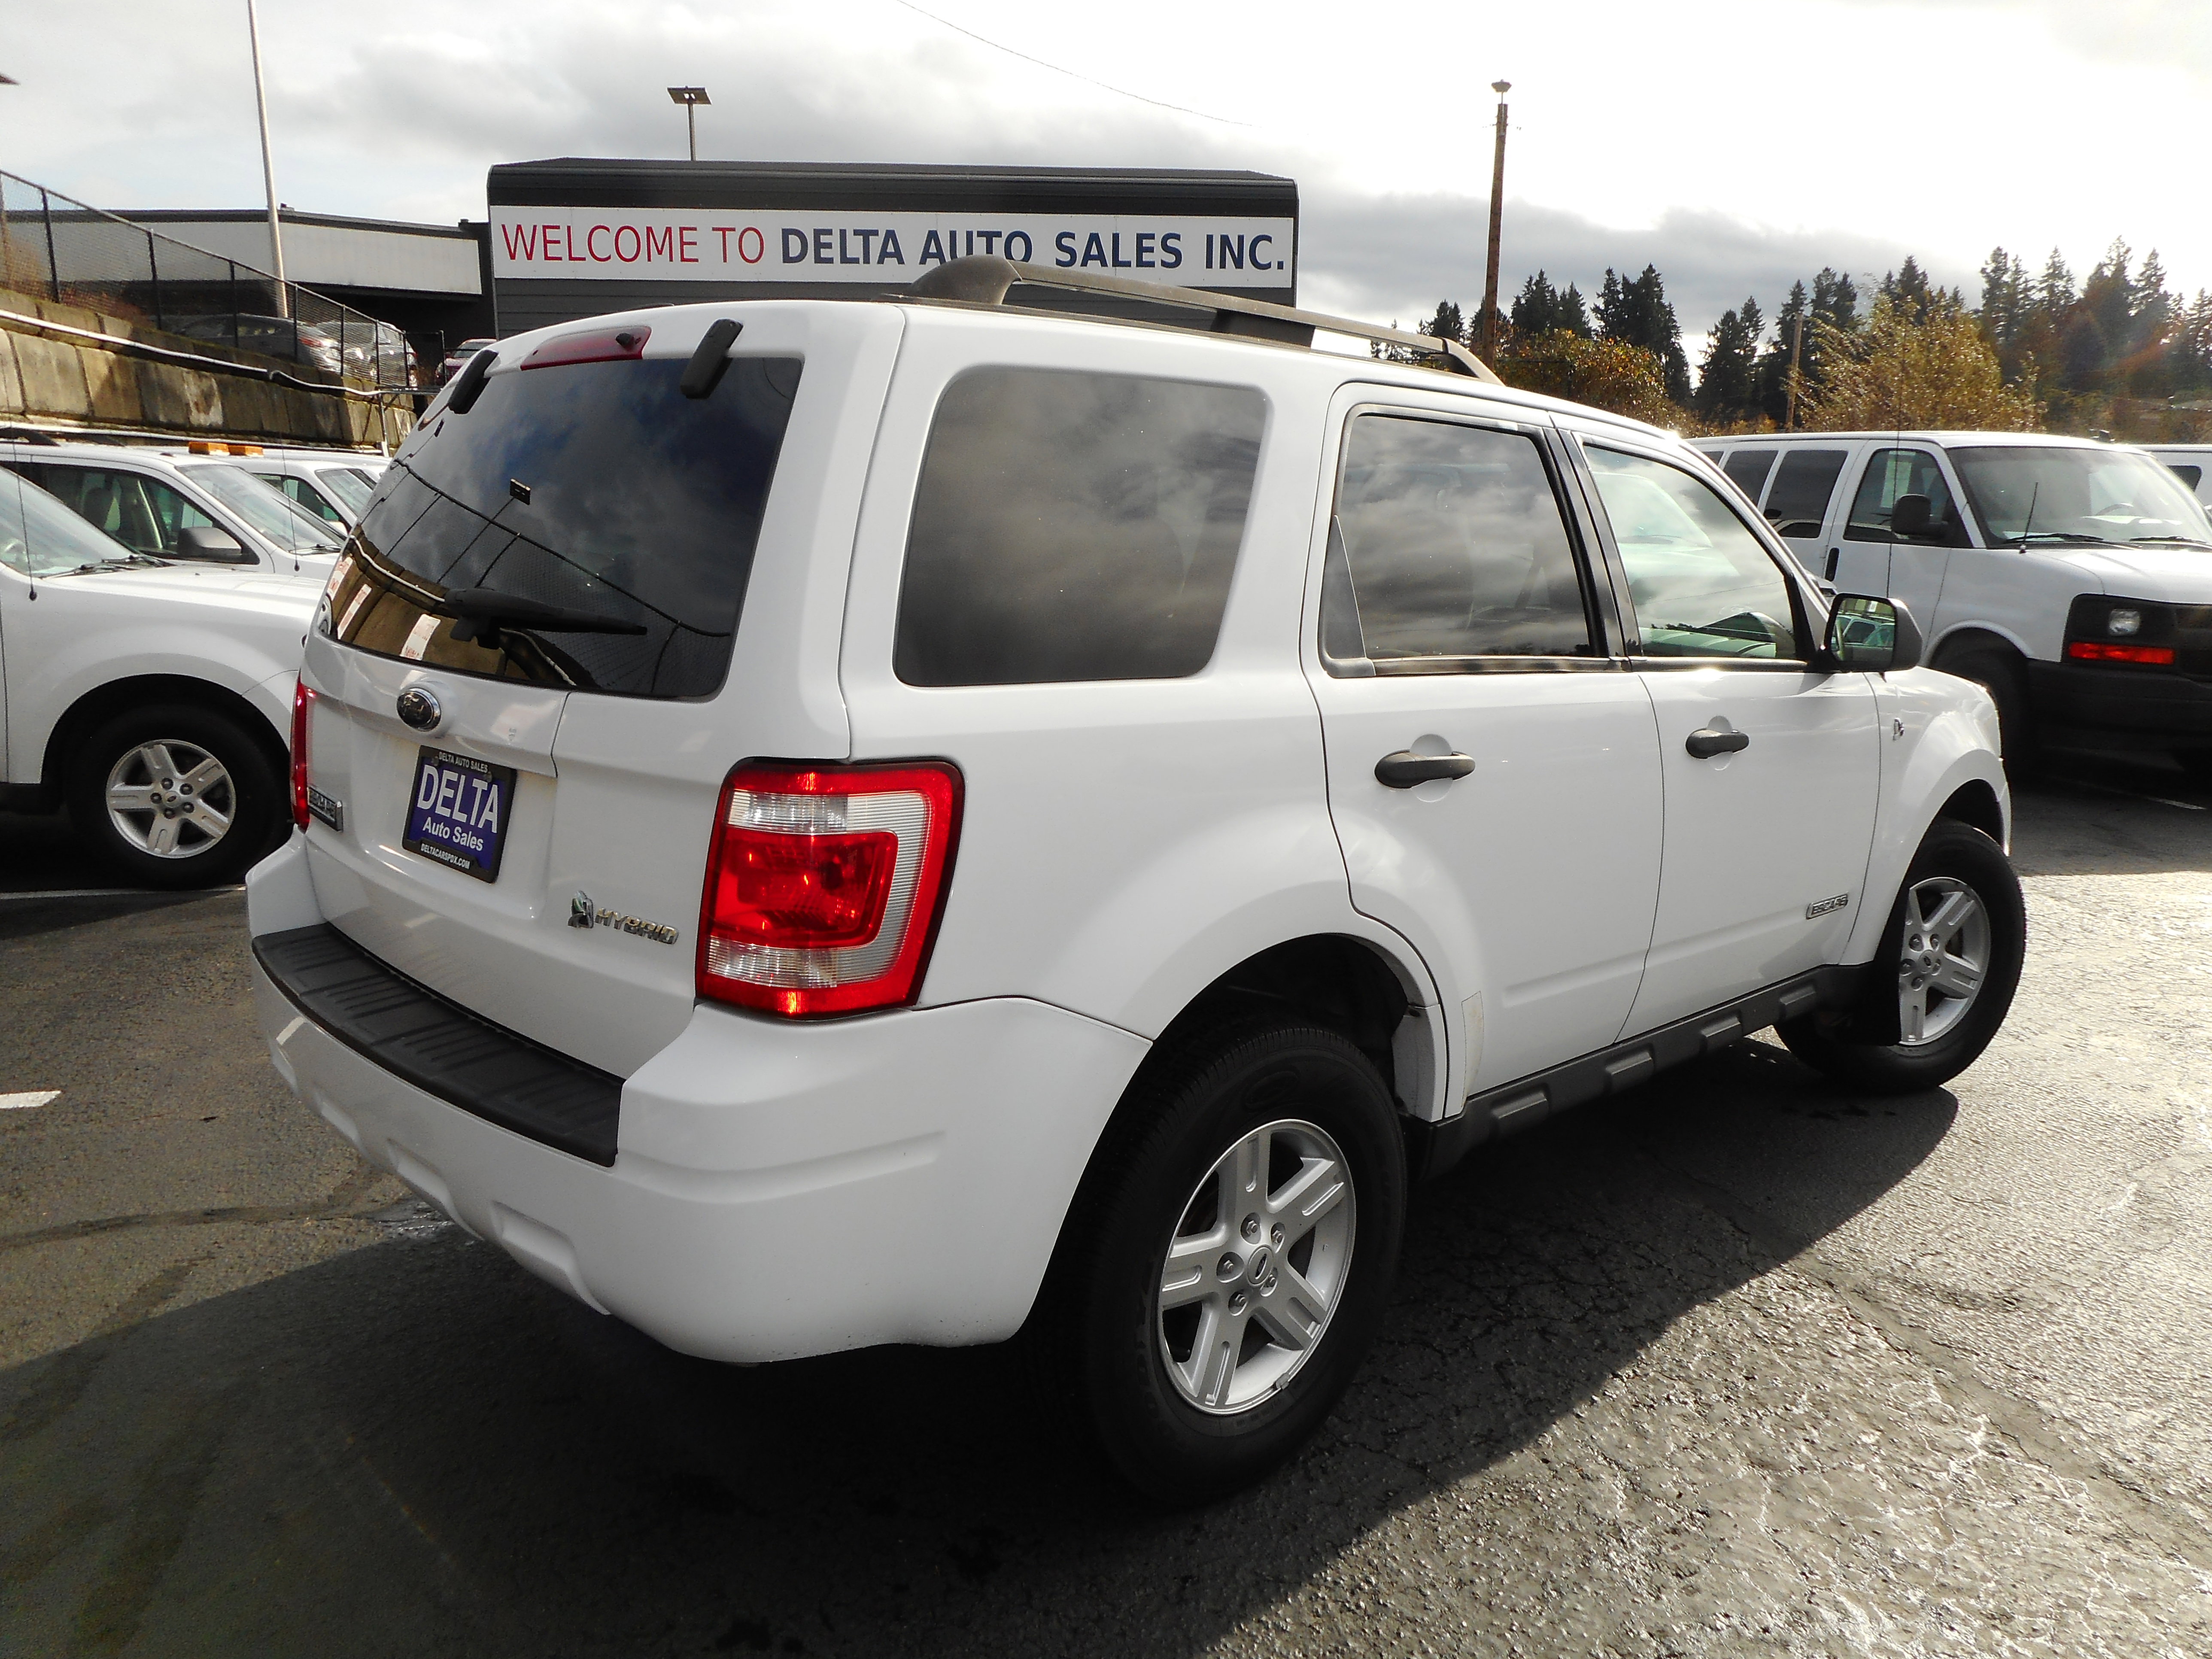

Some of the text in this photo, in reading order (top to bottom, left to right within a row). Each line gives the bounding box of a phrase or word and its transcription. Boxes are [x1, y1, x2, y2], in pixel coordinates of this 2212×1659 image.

[501, 224, 1284, 270] WELCOME TO DELTA AUTO SALES INC.
[439, 751, 488, 773] DELTA AUTO SALES
[416, 765, 498, 833] DELTA
[422, 816, 484, 851] Auto Sales
[420, 843, 471, 870] DELTACARSPDX.COM
[1810, 894, 1848, 915] ESCAPE
[594, 908, 679, 945] HYBRID
